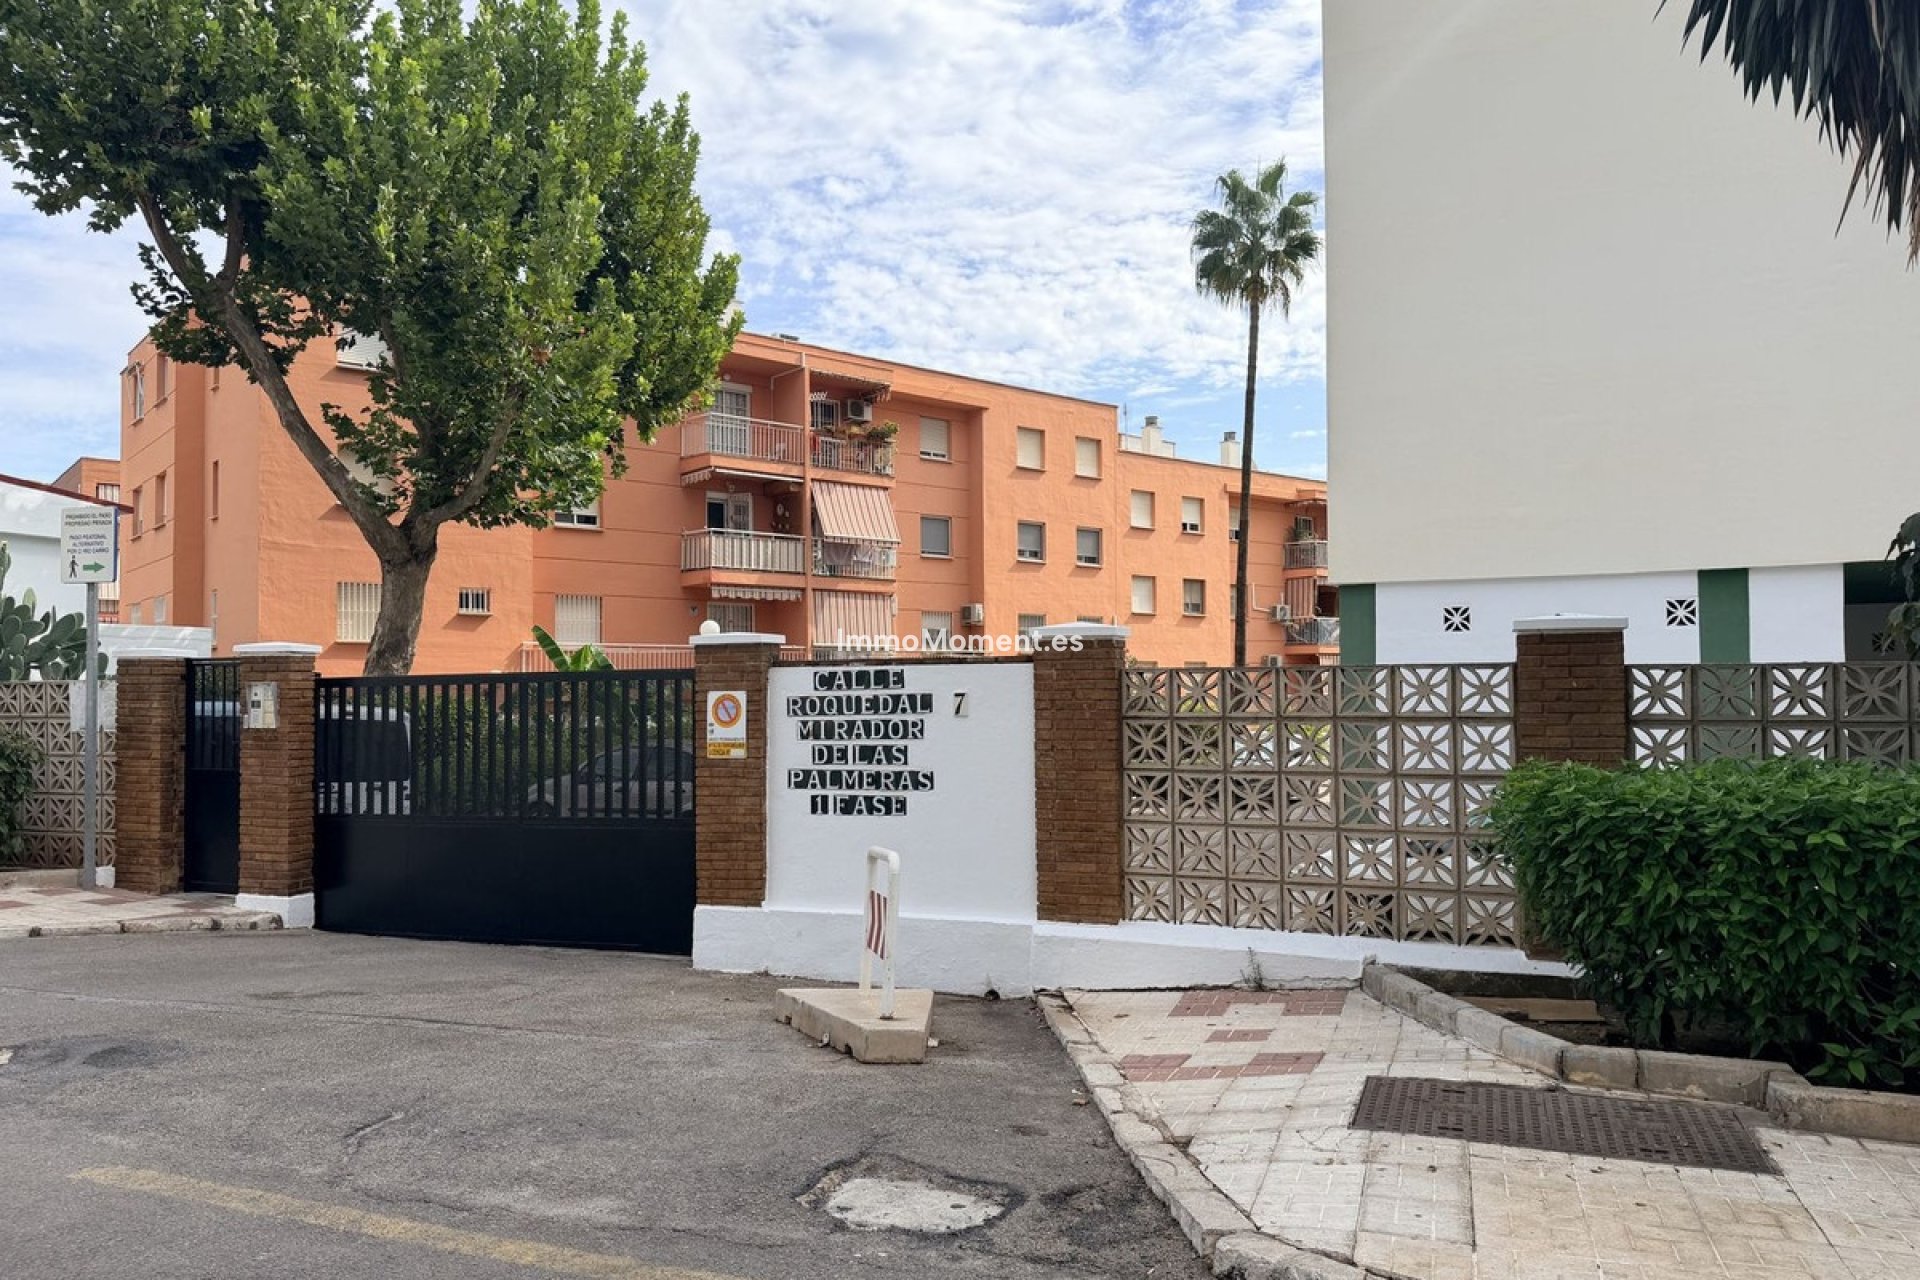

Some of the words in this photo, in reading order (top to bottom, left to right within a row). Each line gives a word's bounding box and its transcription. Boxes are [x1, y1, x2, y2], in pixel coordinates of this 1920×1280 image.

[813, 669, 905, 691] CALLE
[787, 693, 933, 716] ROQUEDAL
[953, 692, 967, 716] 7
[797, 719, 925, 740] MIRADOR
[814, 745, 848, 765] DE
[852, 745, 908, 765] LAS
[788, 769, 934, 791] PALMERAS
[813, 796, 827, 815] 1
[835, 795, 907, 815] FASE
